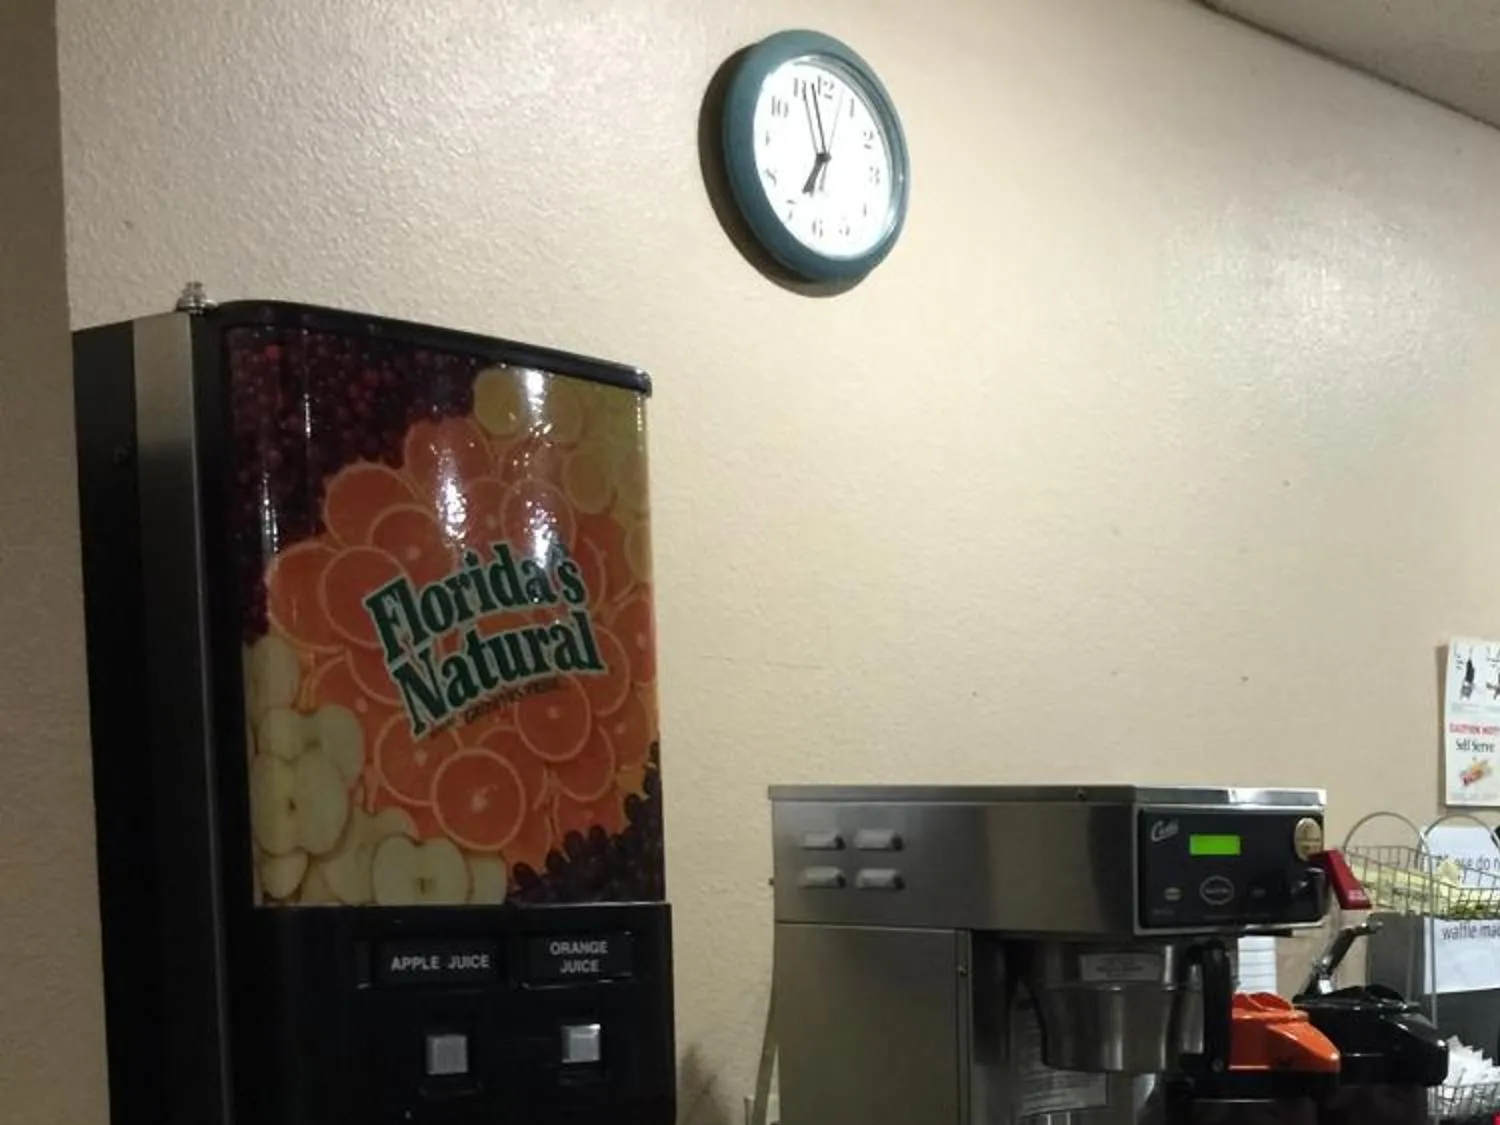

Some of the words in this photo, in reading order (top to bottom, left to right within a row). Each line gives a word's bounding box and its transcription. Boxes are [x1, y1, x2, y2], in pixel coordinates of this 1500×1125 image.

[817, 75, 835, 100] 12
[771, 95, 789, 118] 10
[366, 541, 588, 666] Florida's
[391, 610, 607, 739] Natural
[549, 941, 609, 956] ORANGE
[390, 955, 440, 971] APPLE
[448, 954, 490, 969] JUICE
[560, 959, 600, 974] JUICE
